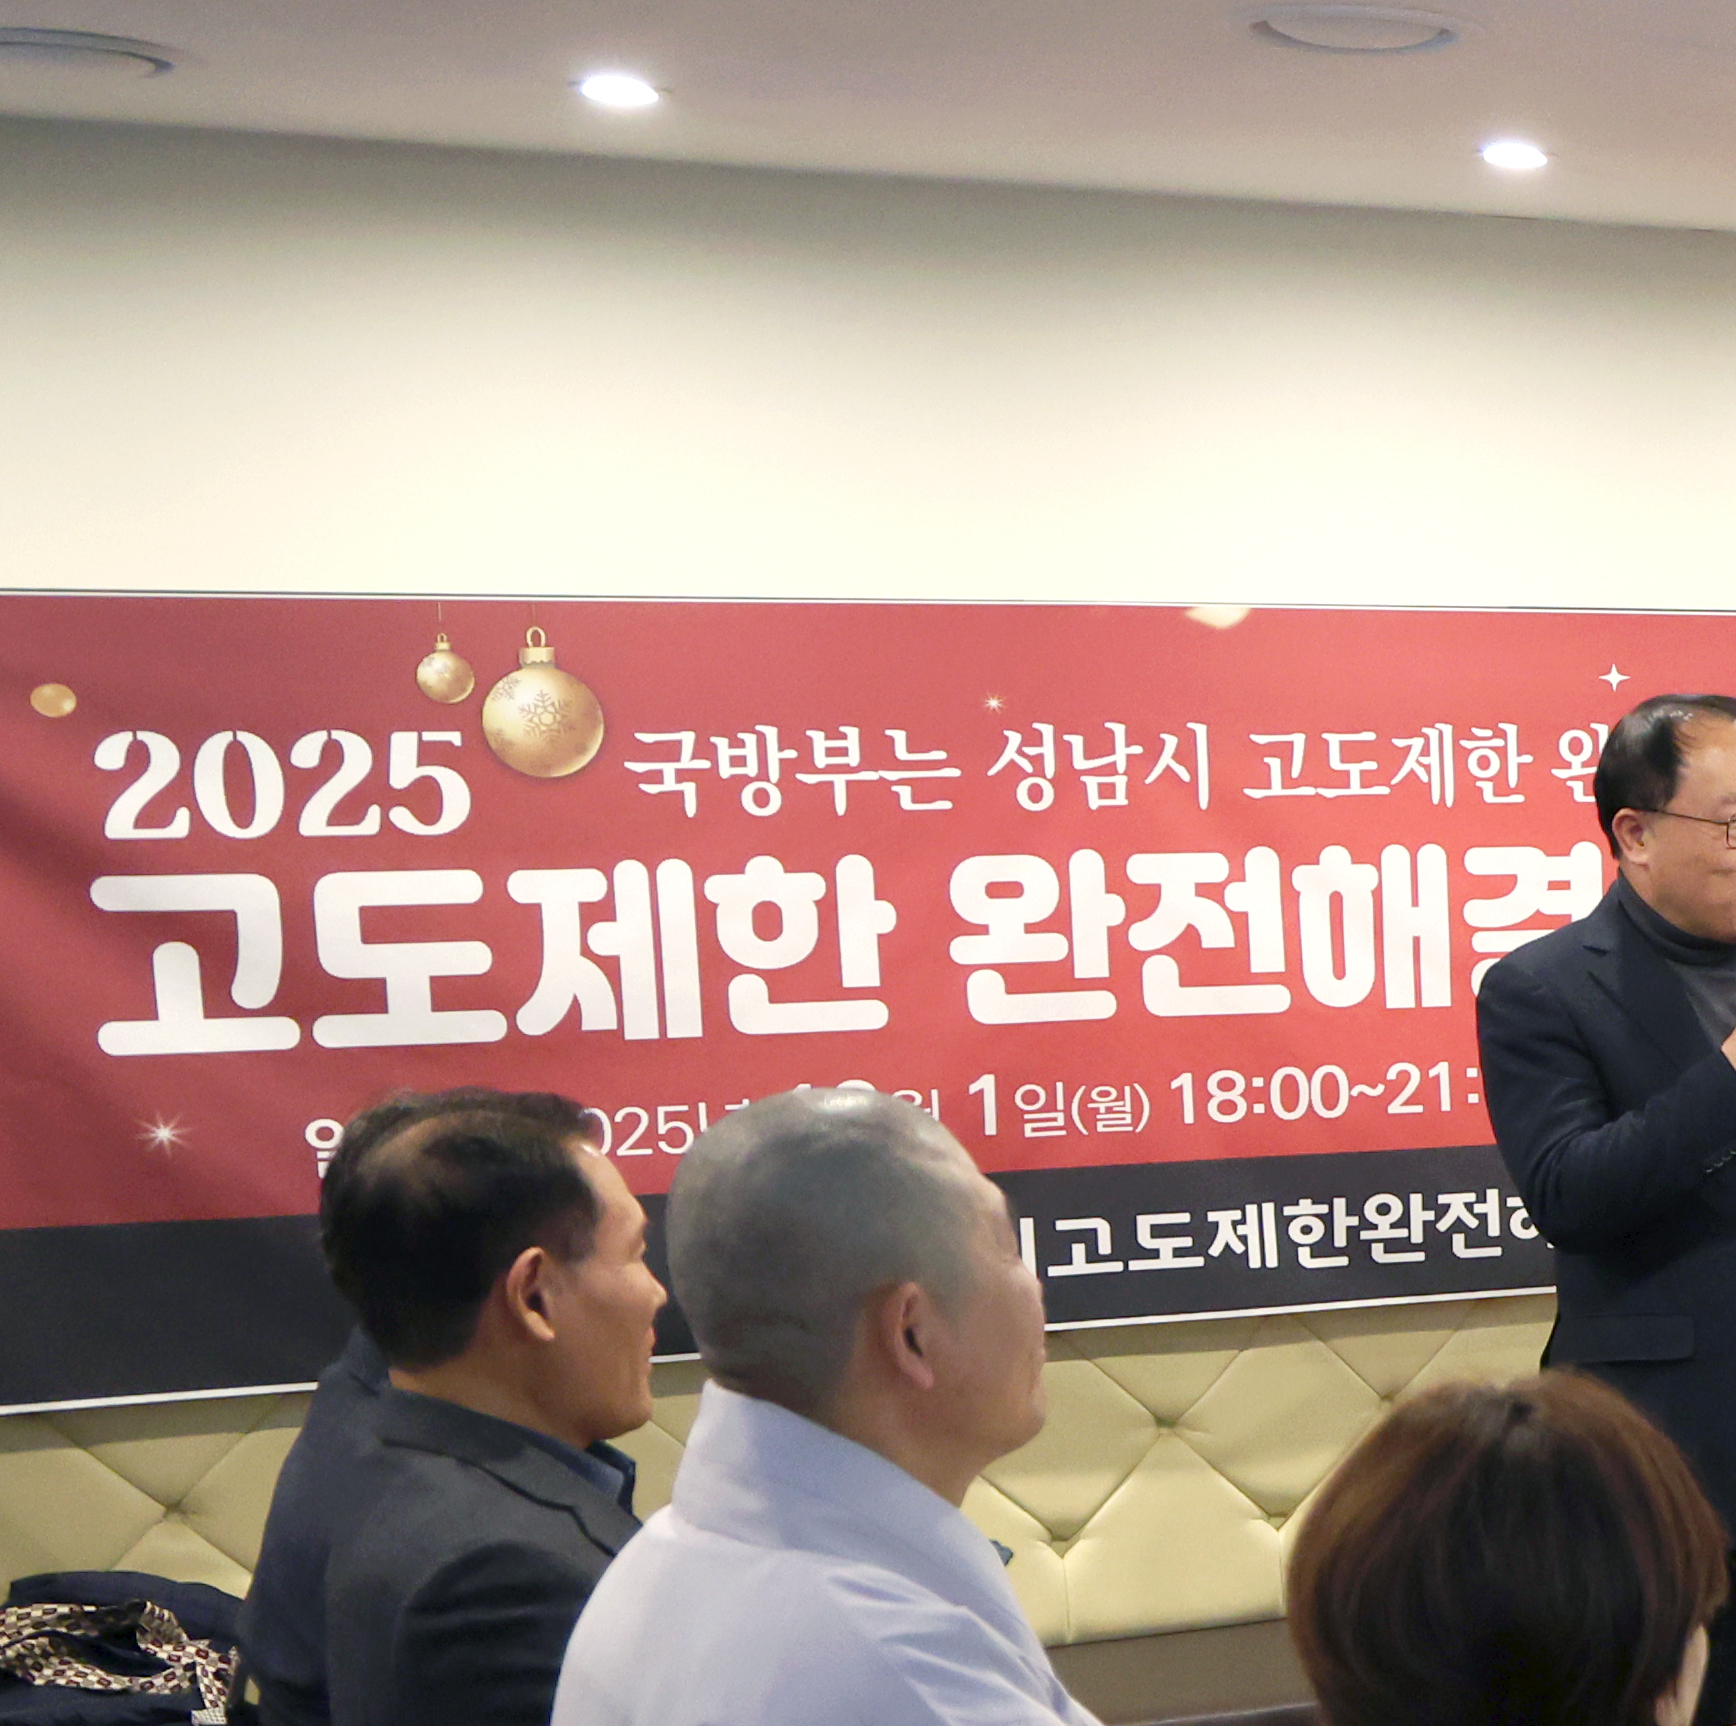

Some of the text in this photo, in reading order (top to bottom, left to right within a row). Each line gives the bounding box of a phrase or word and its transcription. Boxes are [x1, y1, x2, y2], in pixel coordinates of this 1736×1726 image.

[94, 730, 470, 839] 2025
[623, 724, 961, 817] 국방부는
[987, 721, 1207, 810] 성남시
[1244, 720, 1532, 805] 고도제한
[1551, 722, 1604, 804] 완
[91, 853, 897, 1057] 고도제한
